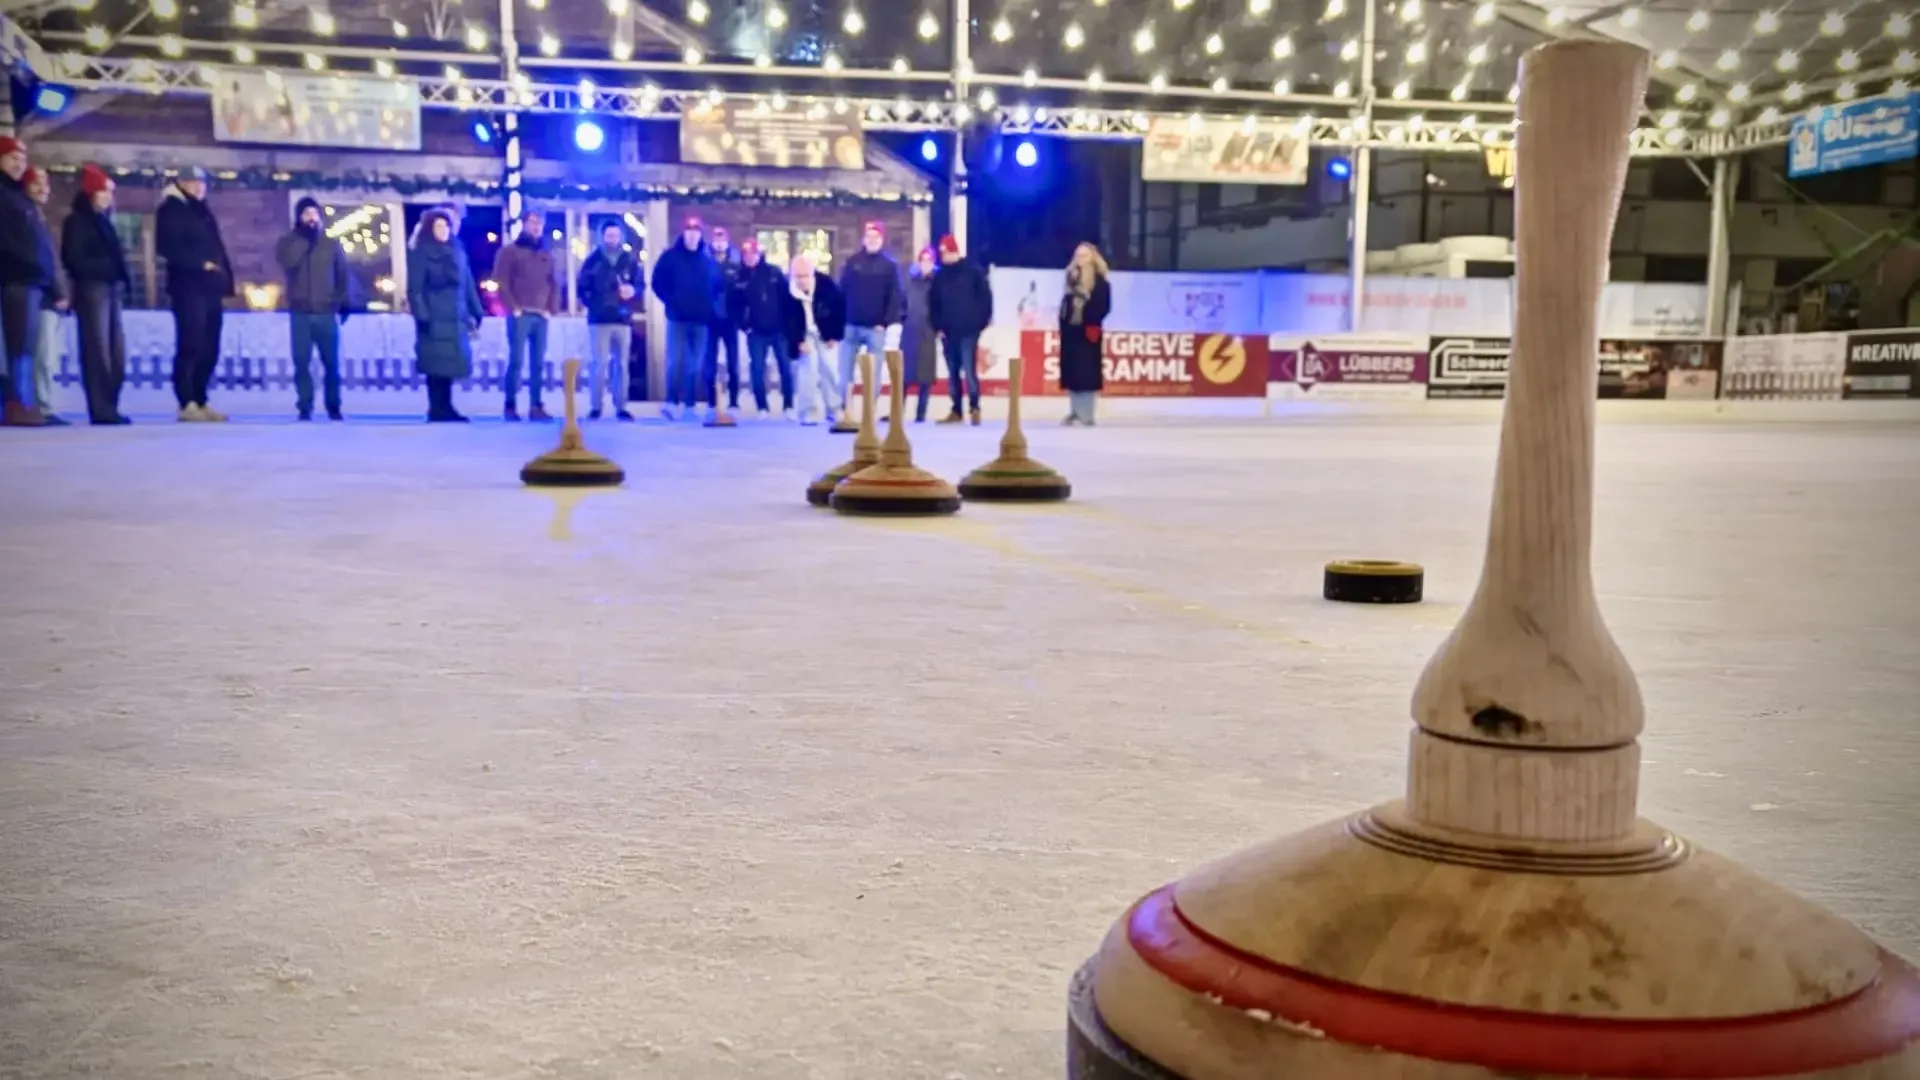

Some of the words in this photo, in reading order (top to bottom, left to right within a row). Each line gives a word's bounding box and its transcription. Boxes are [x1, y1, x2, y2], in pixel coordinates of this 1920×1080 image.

[1043, 332, 1195, 356] HTGREVE
[1043, 357, 1193, 382] SRAMML
[1339, 354, 1416, 372] LÜBBERS
